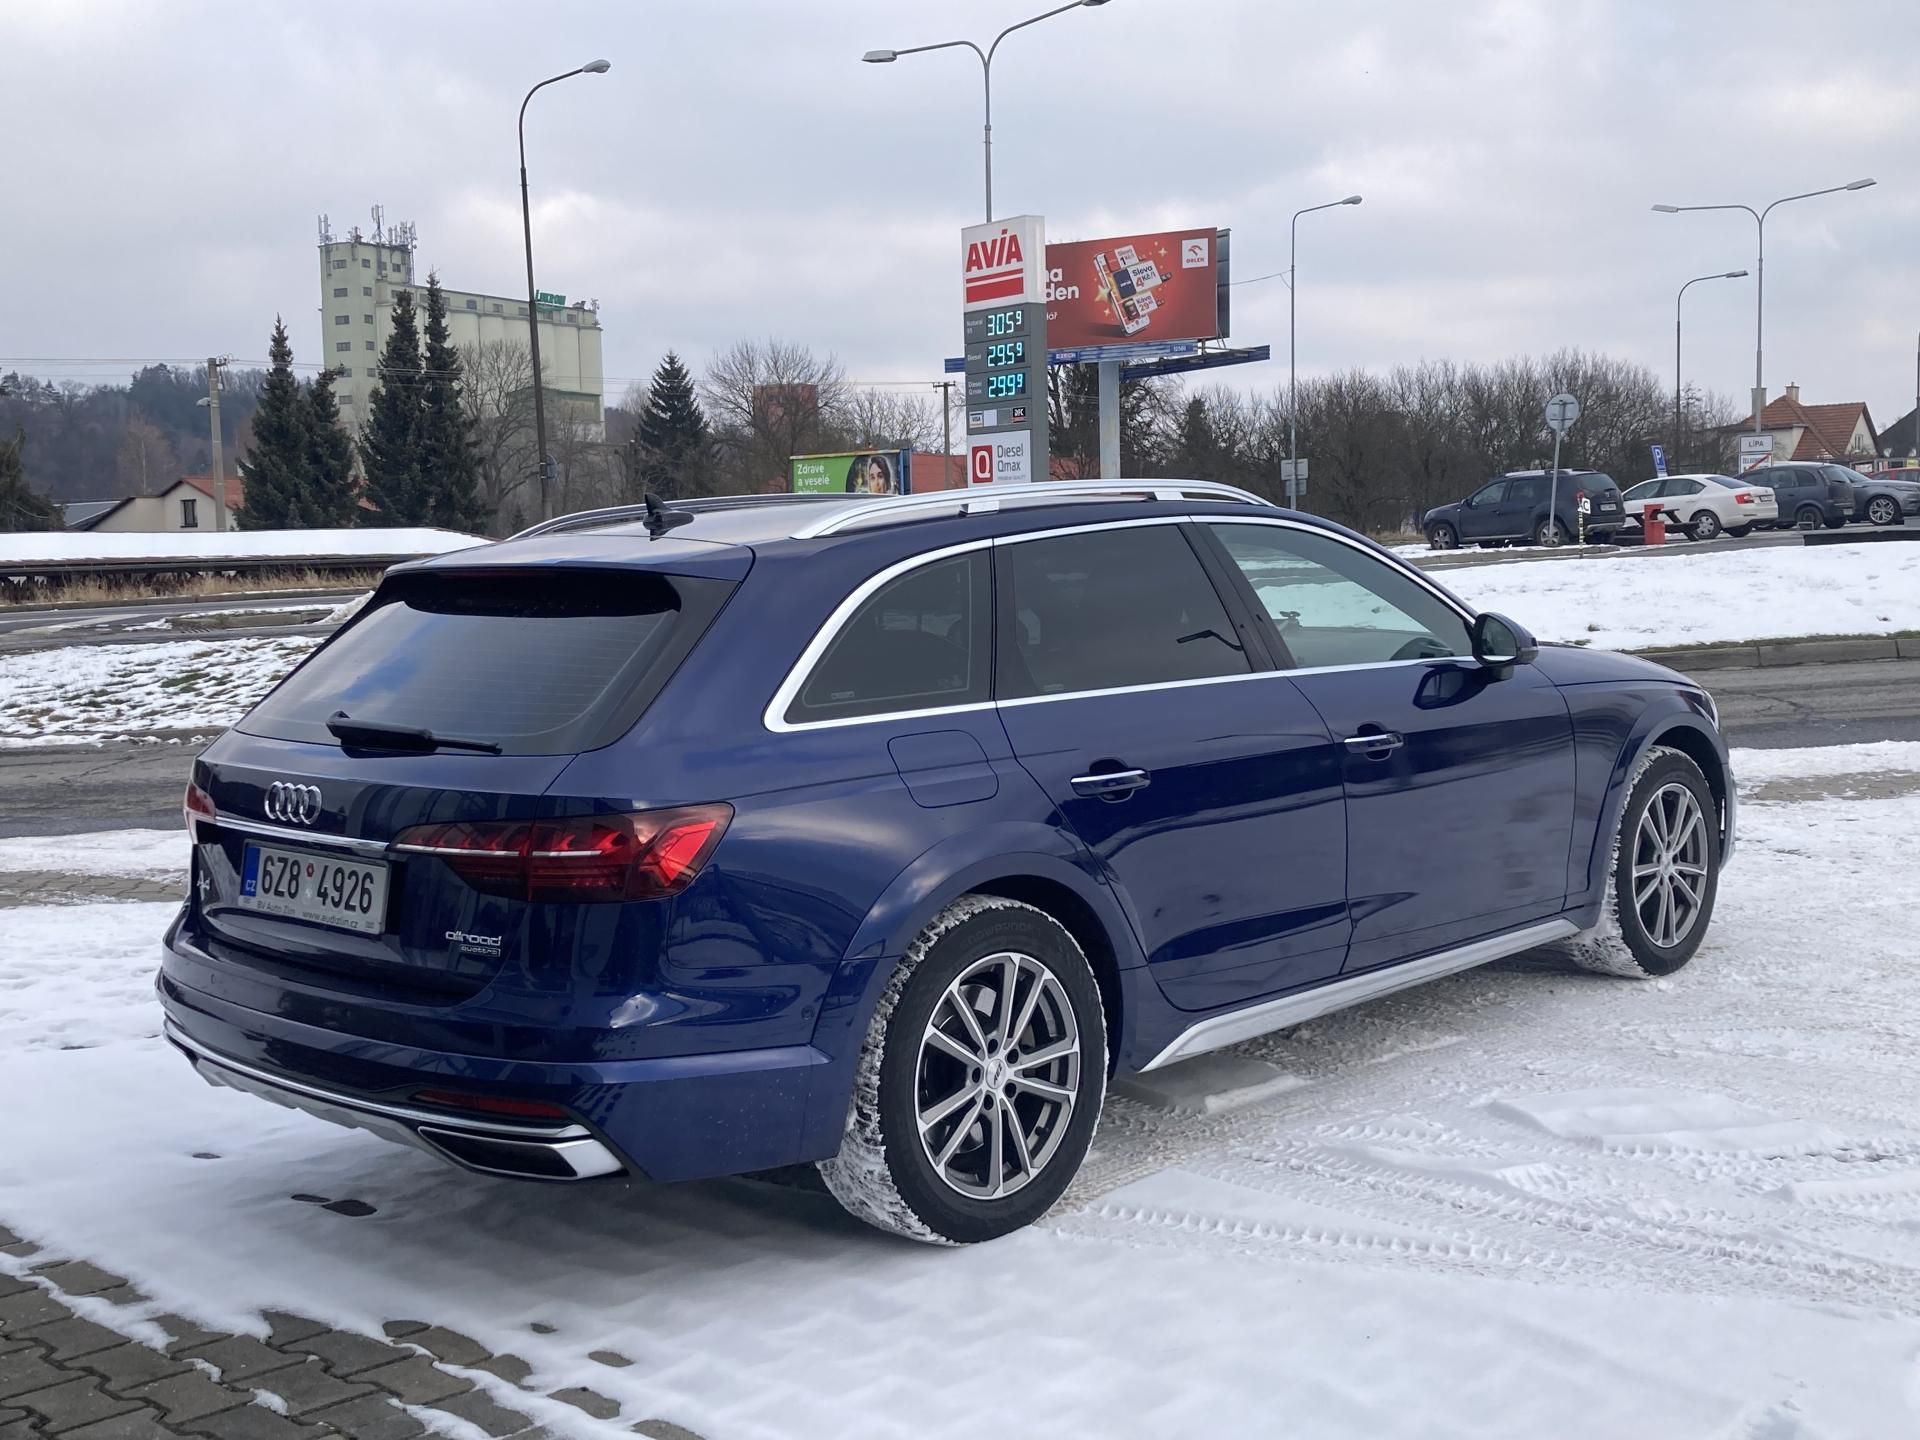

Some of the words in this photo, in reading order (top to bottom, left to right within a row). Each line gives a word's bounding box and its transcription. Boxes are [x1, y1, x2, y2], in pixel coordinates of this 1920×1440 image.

[1132, 265, 1153, 277] Sleva
[1135, 277, 1144, 288] 4
[1139, 302, 1150, 312] 29
[997, 443, 1024, 459] Diesel
[1654, 448, 1662, 465] P
[975, 450, 991, 479] Q
[997, 460, 1021, 473] Qmax
[798, 478, 803, 487] a
[804, 474, 830, 486] veselé
[245, 879, 257, 892] CZ
[262, 855, 301, 899] 6Z8
[316, 864, 375, 914] 4926
[445, 930, 502, 946] allroad
[461, 945, 499, 956] quattro
